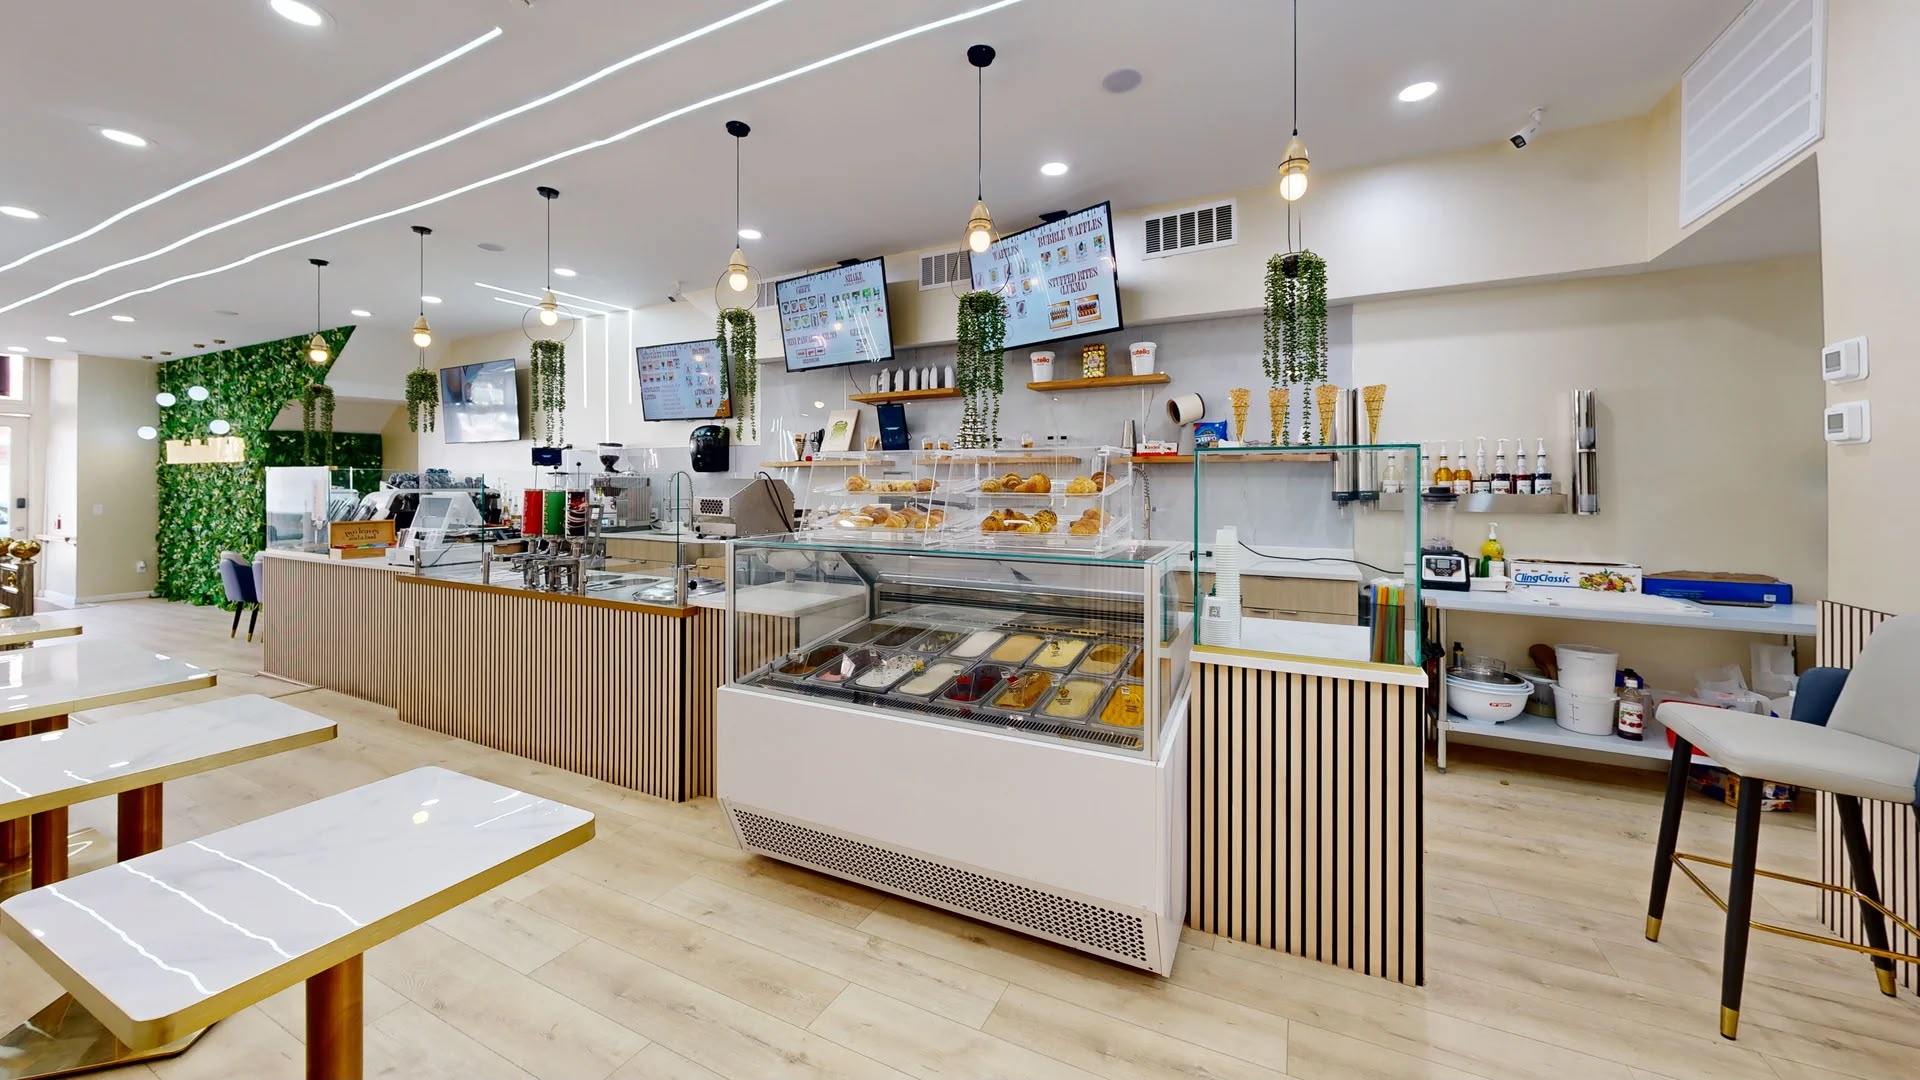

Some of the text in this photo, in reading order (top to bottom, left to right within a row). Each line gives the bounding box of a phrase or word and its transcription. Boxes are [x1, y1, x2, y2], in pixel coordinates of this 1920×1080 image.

[1038, 217, 1103, 248] BUBBLE WAFFLES
[992, 245, 1019, 261] WAFFLES
[1048, 272, 1077, 289] STUFFED
[1514, 573, 1571, 584] ClingClassic
